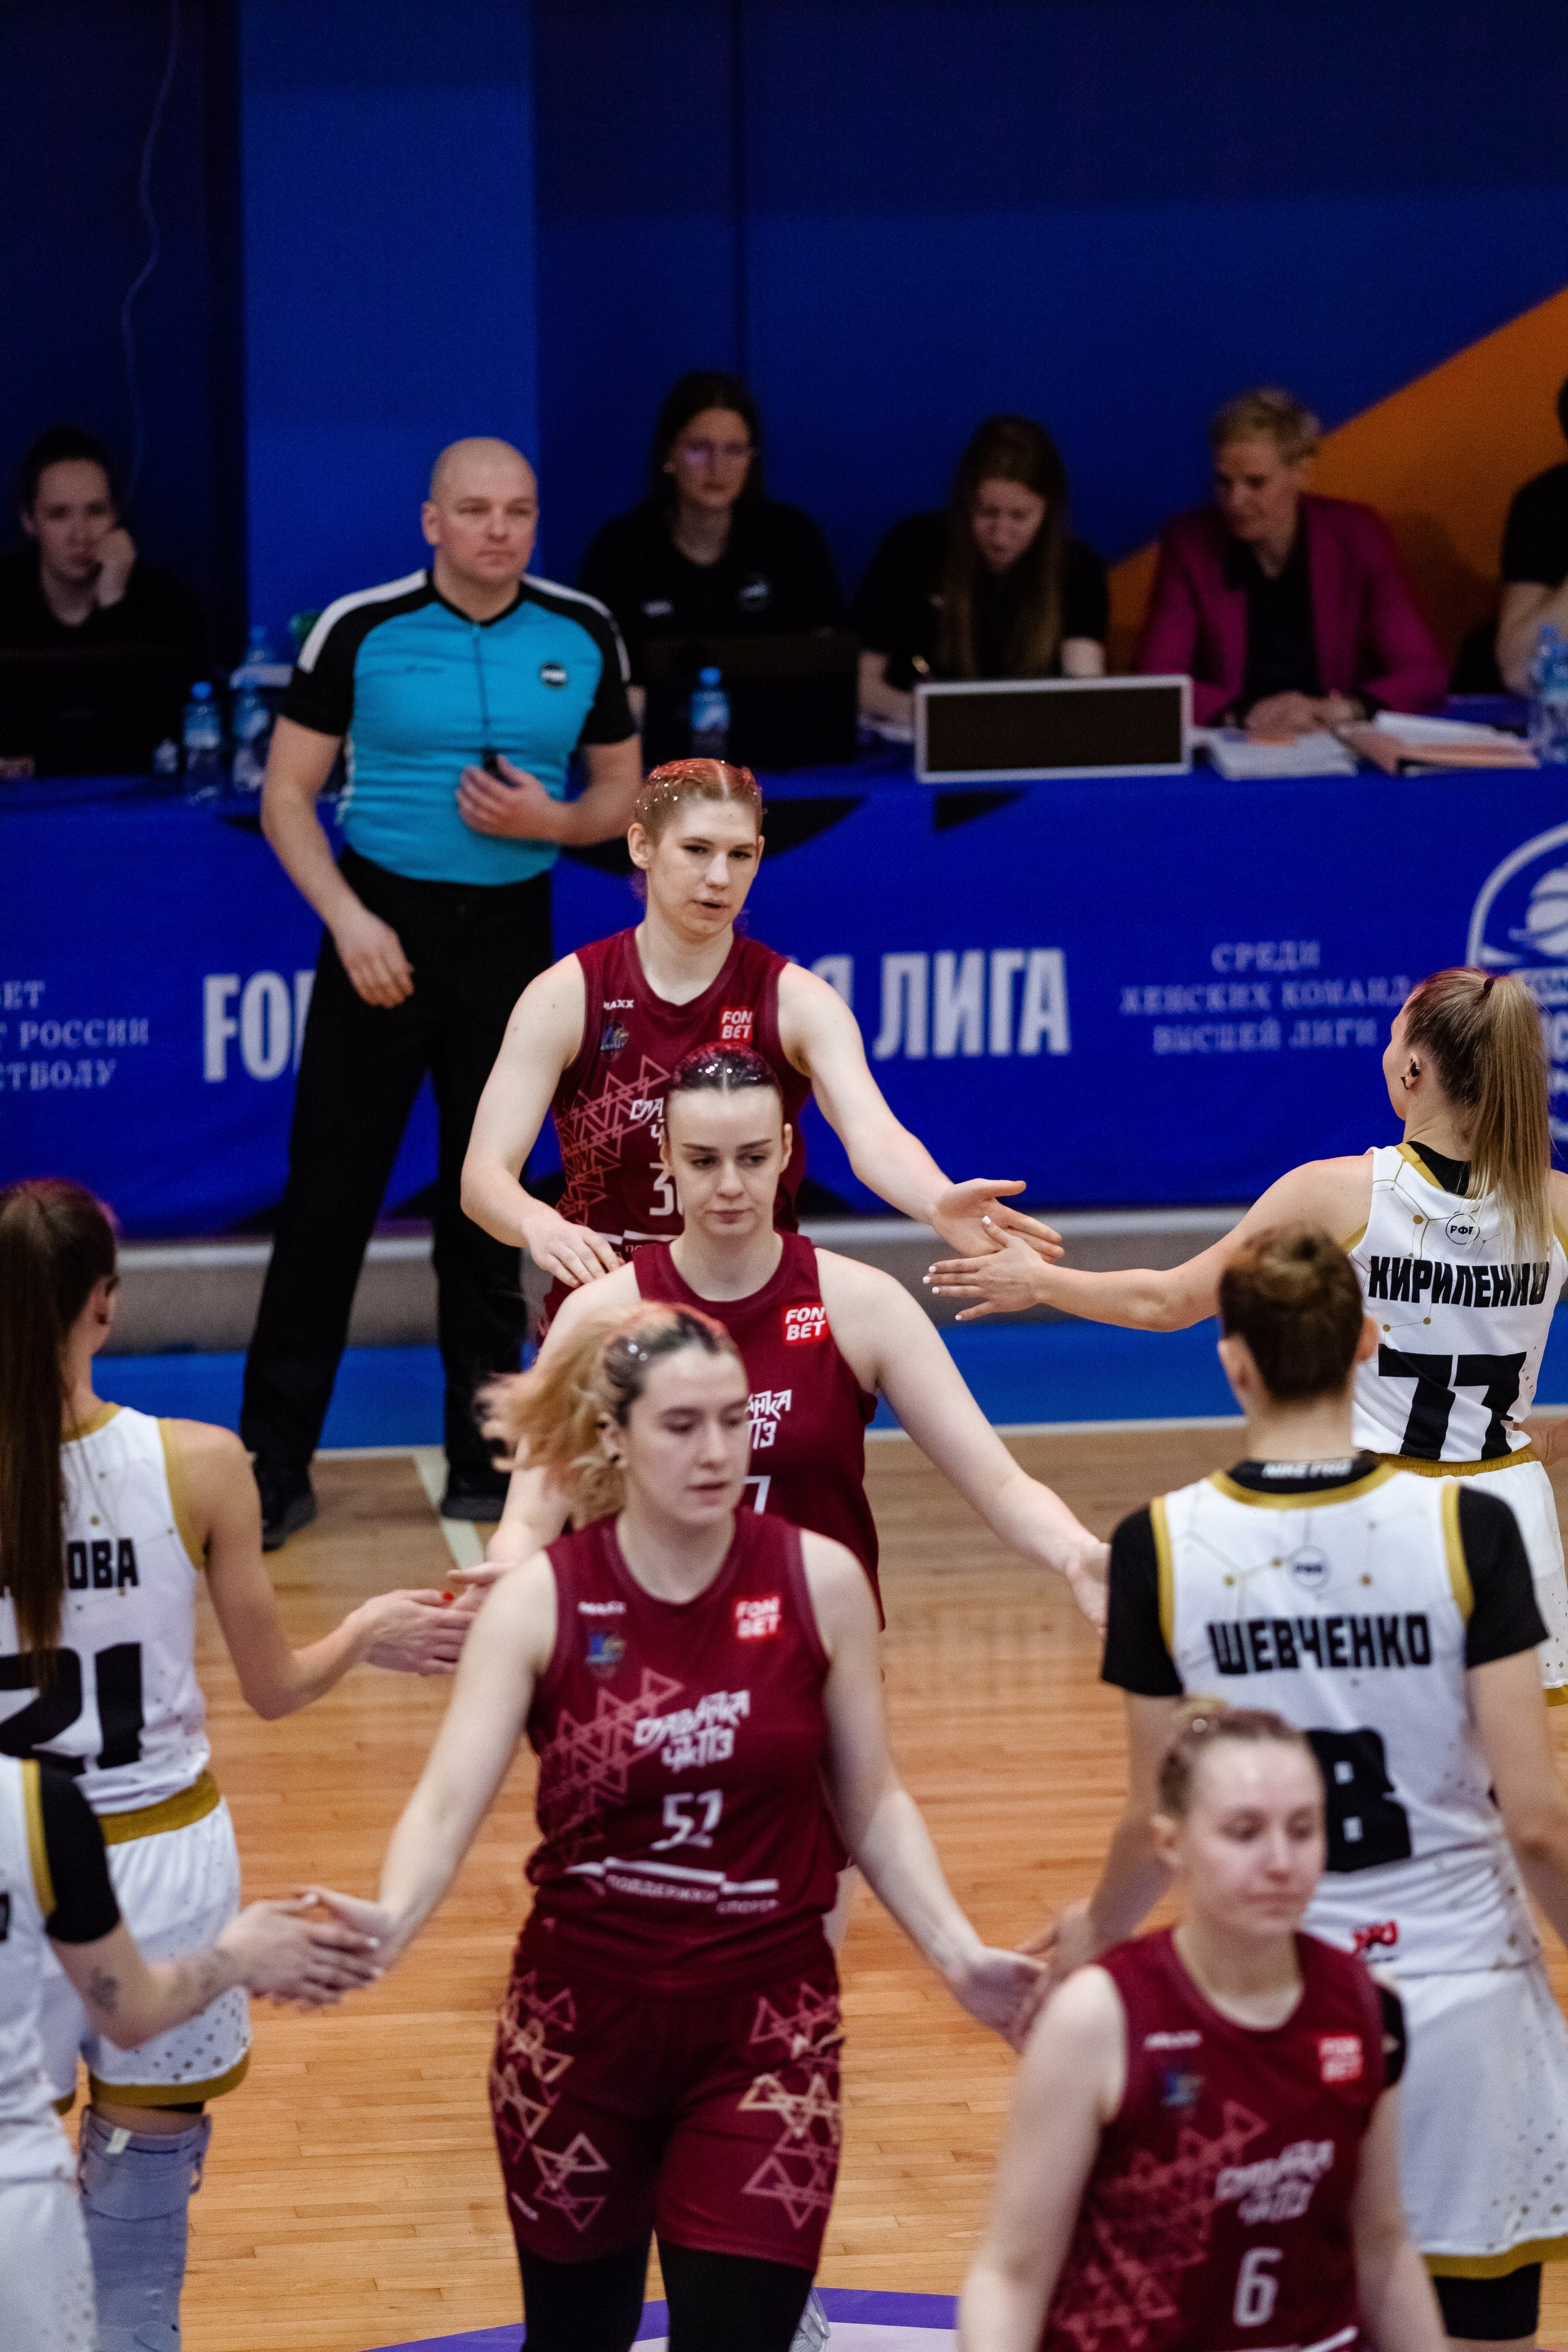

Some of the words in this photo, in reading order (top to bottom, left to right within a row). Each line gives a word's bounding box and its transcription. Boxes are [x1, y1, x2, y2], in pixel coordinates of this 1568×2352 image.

[1212, 939, 1321, 973] СРЕДИ
[2, 979, 46, 1011] ЕТ
[872, 946, 1072, 1061] ЛИГА
[20, 1017, 149, 1051] РОССИИ
[722, 1010, 753, 1025] FON
[722, 1025, 752, 1039] BET
[1368, 1256, 1550, 1308] КИРИЛЕНКО
[785, 1306, 825, 1325] FON
[786, 1320, 826, 1341] BET
[1378, 1343, 1528, 1461] 77
[1207, 1611, 1431, 1675] ШЕВЧЕНКО
[650, 1789, 724, 1851] 52
[1232, 2246, 1284, 2328] 6
